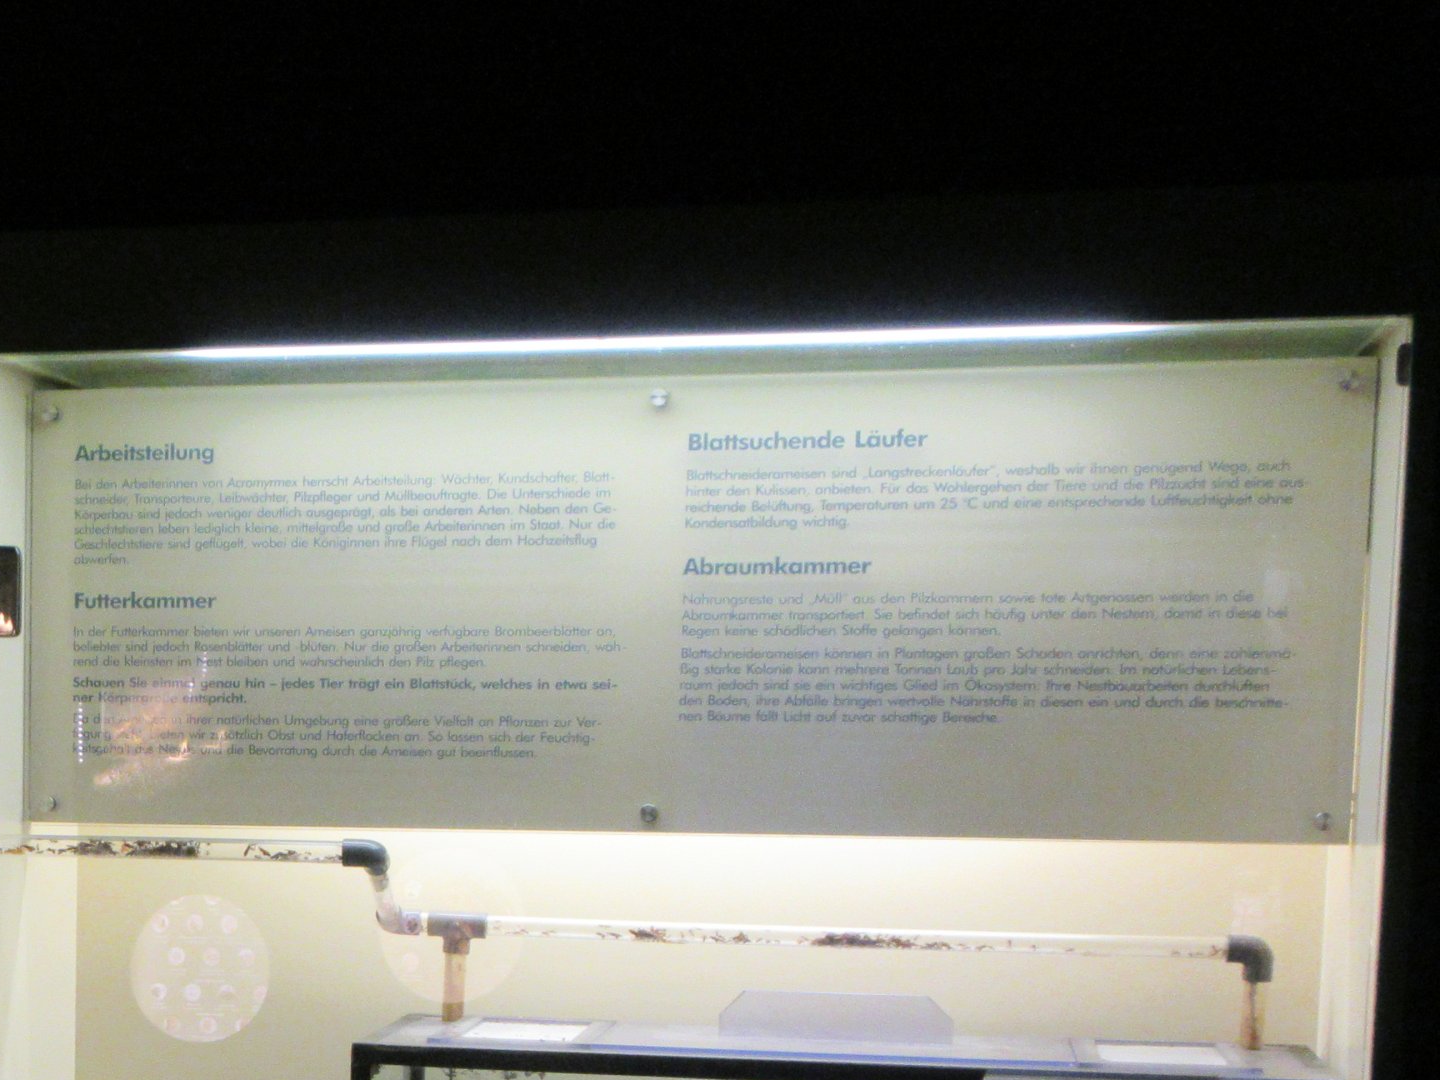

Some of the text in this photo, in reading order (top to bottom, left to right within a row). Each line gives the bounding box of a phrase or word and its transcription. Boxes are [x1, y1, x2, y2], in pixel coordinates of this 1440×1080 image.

[688, 428, 928, 451] Blattsuchende Läufer
[75, 443, 215, 464] Arbeitsteilung
[831, 467, 857, 479] sind
[1065, 465, 1085, 475] wir
[74, 478, 91, 490] Bei
[96, 478, 117, 489] den
[202, 479, 223, 488] von
[685, 485, 720, 497] hinter
[726, 485, 750, 496] den
[906, 482, 929, 494] das
[1027, 481, 1049, 492] der
[1092, 480, 1118, 491] und
[1123, 479, 1143, 491] die
[357, 489, 380, 501] und
[487, 488, 507, 499] Die
[596, 488, 611, 498] im
[137, 507, 160, 519] sind
[164, 507, 202, 522] jedoch
[208, 508, 252, 522] weniger
[257, 506, 301, 518] deutlich
[379, 505, 396, 517] als
[400, 505, 418, 516] bei
[423, 504, 473, 516] anderen
[564, 502, 588, 514] den
[685, 501, 746, 512] reichende
[913, 501, 935, 510] um
[940, 498, 957, 510] 25
[158, 522, 189, 534] leben
[357, 520, 380, 532] und
[510, 520, 525, 530] im
[569, 518, 592, 530] Nur
[597, 518, 615, 529] die
[167, 537, 190, 549] sind
[291, 536, 308, 548] die
[385, 536, 407, 547] ihre
[452, 535, 480, 547] nach
[485, 535, 512, 547] dem
[683, 556, 872, 575] Abraumkammer
[74, 592, 216, 609] Futterkammer
[779, 593, 803, 605] und
[880, 592, 905, 604] den
[88, 626, 106, 637] der
[111, 626, 188, 637] Futterkammer
[233, 627, 249, 637] wir
[73, 675, 124, 688] Schauen
[129, 676, 147, 688] Sie
[201, 679, 240, 692] genau
[245, 676, 265, 688] hin
[281, 676, 315, 692] jedes
[320, 676, 344, 689] Tier
[349, 678, 380, 692] trägt
[384, 678, 404, 689] ein
[481, 677, 533, 690] welches
[537, 679, 550, 690] in
[555, 679, 587, 690] etwa
[592, 679, 618, 690] sei-
[354, 716, 379, 726] eine
[478, 719, 494, 727] an
